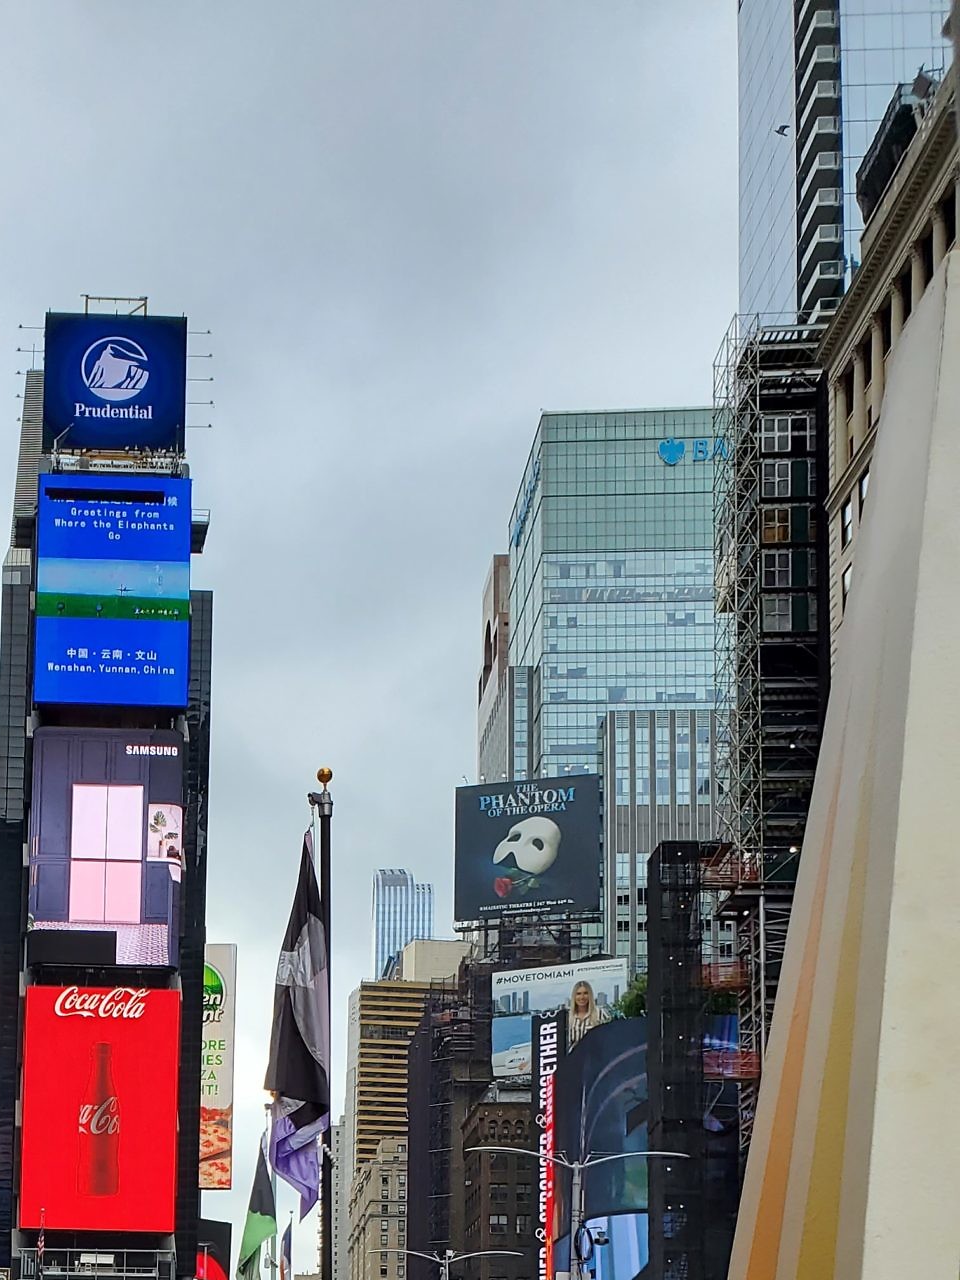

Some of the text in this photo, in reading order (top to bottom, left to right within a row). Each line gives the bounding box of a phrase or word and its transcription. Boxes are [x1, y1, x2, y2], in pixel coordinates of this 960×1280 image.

[74, 402, 153, 420] Prudential
[71, 508, 160, 519] Greetings from
[54, 518, 175, 531] Where the Elephants
[108, 532, 121, 541] Go
[125, 745, 178, 757] SAMSUNG
[514, 783, 538, 793] THE
[479, 787, 576, 811] PHANTOM
[487, 802, 567, 818] OF THE OPERA
[496, 969, 575, 985] #MOVETOMIAMI
[54, 986, 151, 1019] Coca-Cola
